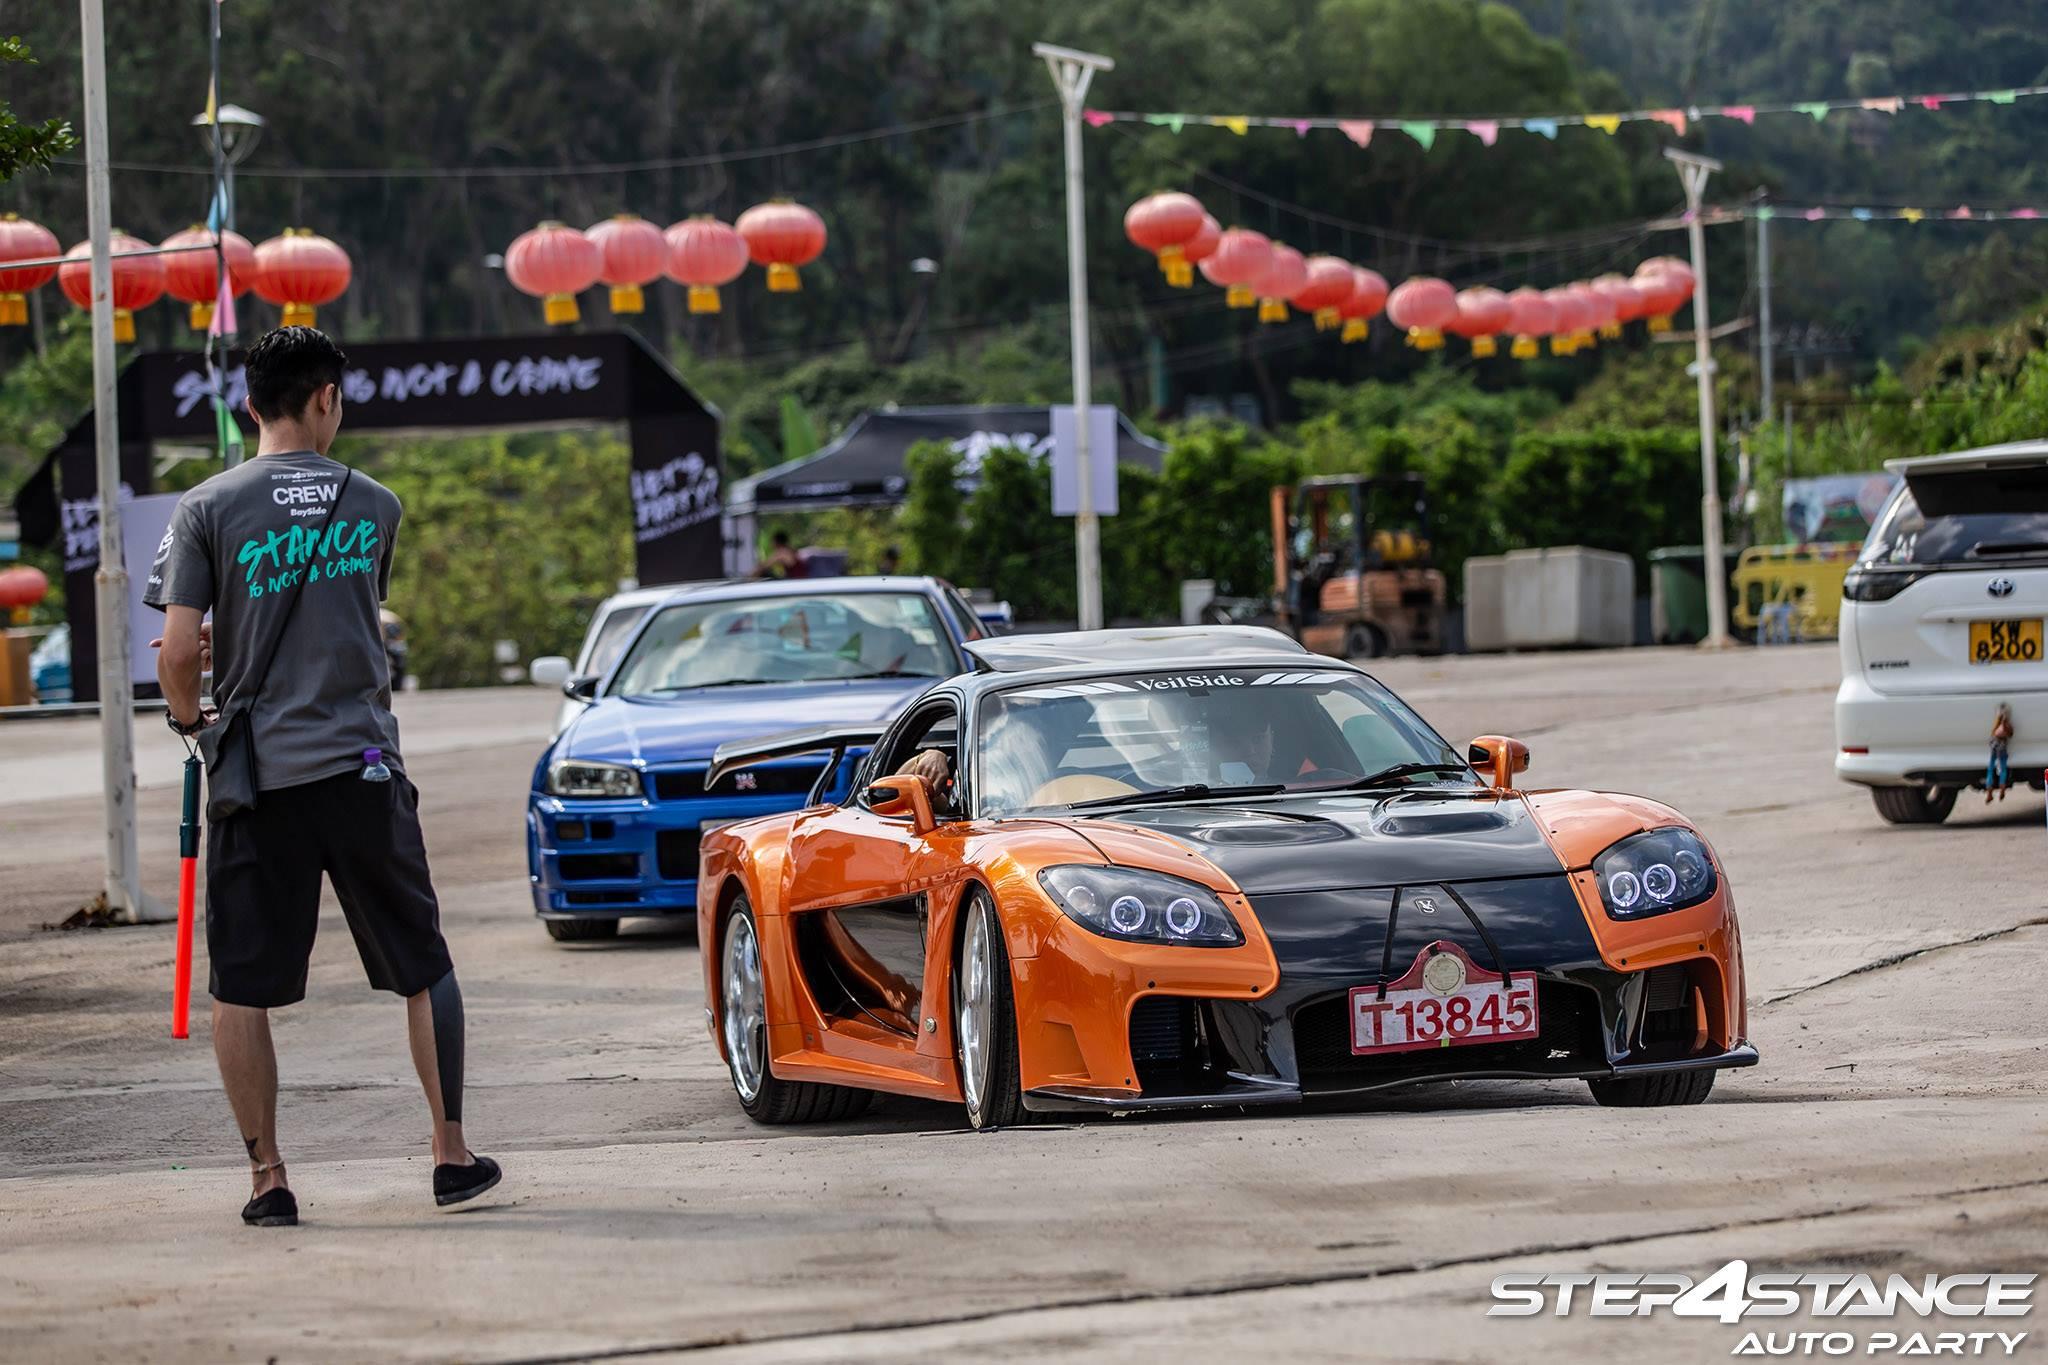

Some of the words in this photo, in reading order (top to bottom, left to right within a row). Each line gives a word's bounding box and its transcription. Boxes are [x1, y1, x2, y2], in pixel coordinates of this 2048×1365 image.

[381, 361, 459, 401] NOT
[458, 359, 482, 397] A
[490, 355, 603, 397] CRIME
[272, 483, 339, 505] CREW
[290, 506, 327, 517] BaySide
[237, 519, 379, 583] STANCE
[248, 581, 264, 598] IS
[267, 569, 302, 593] NOT
[309, 564, 321, 583] A
[326, 556, 374, 578] CRIME
[1990, 621, 2021, 640] KW
[1976, 638, 2037, 660] 8200
[1134, 674, 1245, 691] VeilSide
[1360, 991, 1533, 1045] T13845
